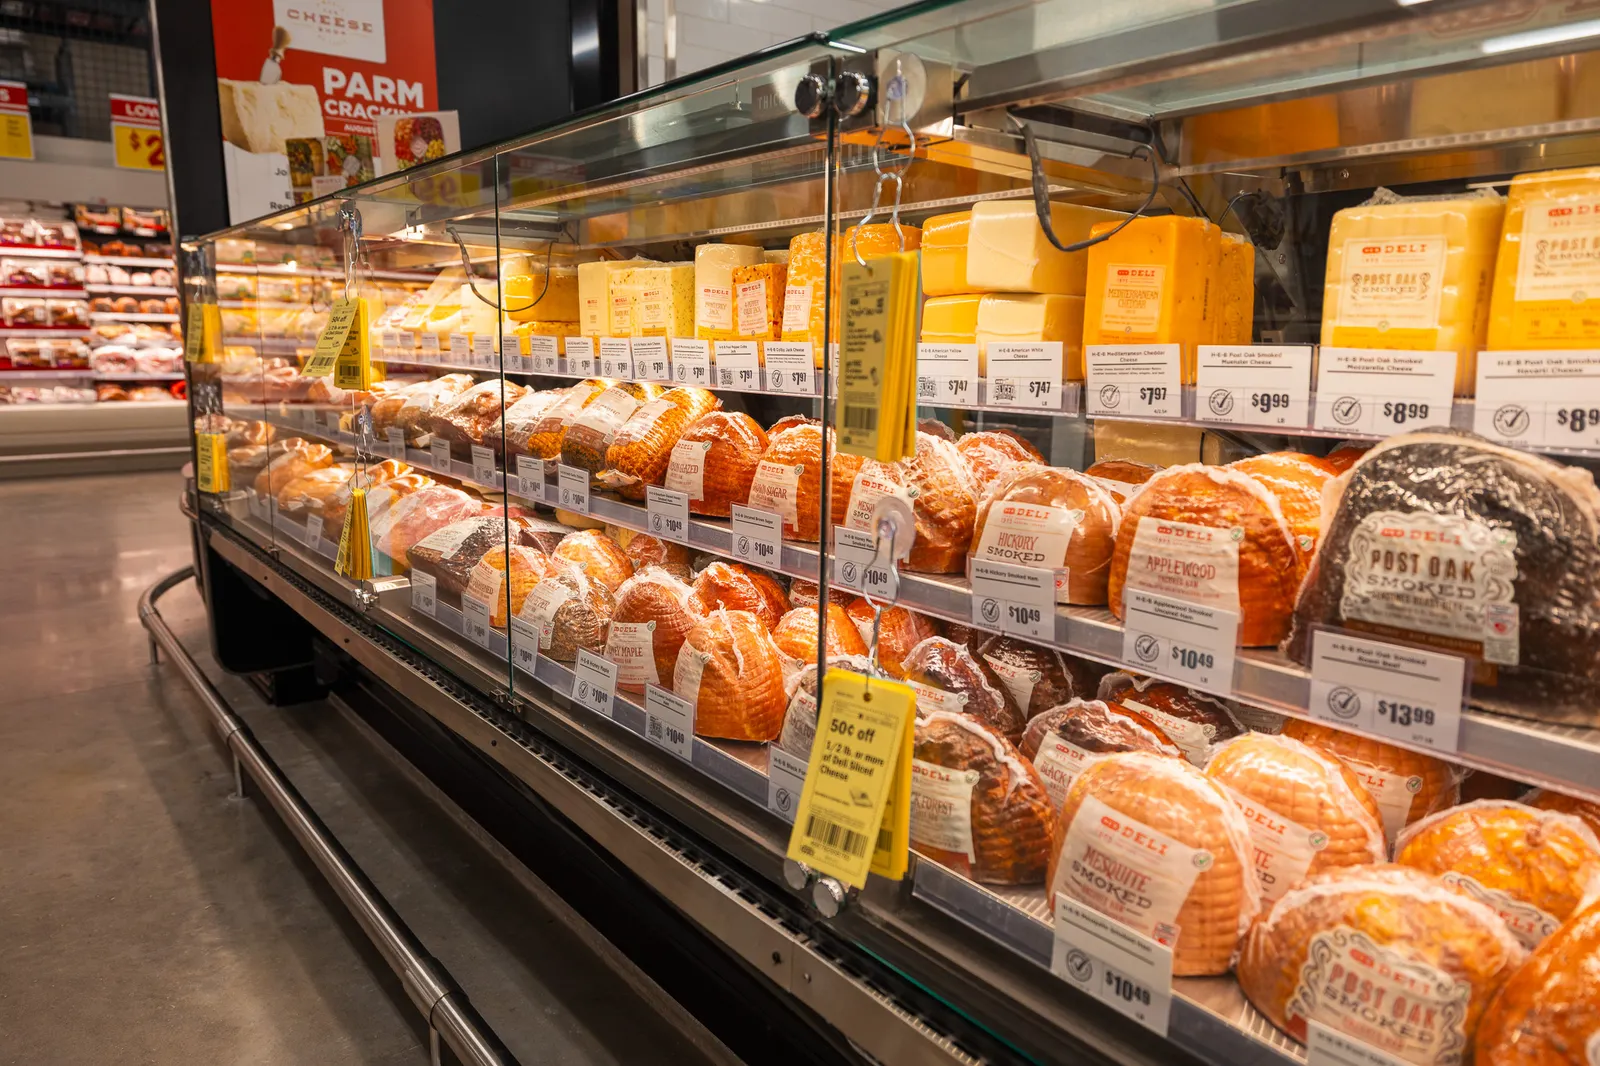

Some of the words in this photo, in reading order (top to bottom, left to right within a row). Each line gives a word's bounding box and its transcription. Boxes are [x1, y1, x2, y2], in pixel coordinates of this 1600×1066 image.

[287, 9, 373, 33] CHEESE
[322, 67, 424, 108] PARM
[1384, 244, 1427, 254] DELI
[1131, 269, 1155, 277] DELI
[1363, 273, 1391, 285] POST
[1362, 286, 1417, 294] SMOKED
[739, 370, 752, 383] $797
[792, 372, 806, 386] $797
[949, 380, 968, 395] $747
[1029, 381, 1051, 398] $747
[1140, 387, 1167, 405] $797
[1251, 393, 1289, 413] $999
[1383, 402, 1429, 424] $899
[766, 485, 788, 500] SUGAR
[871, 481, 896, 495] DELI
[1016, 508, 1050, 520] DELI
[666, 519, 682, 532] $1049
[997, 532, 1039, 551] HICKORY
[1175, 529, 1213, 542] DELI
[1410, 529, 1462, 546] DELI
[754, 541, 774, 557] $1049
[987, 546, 1045, 563] SMOKED
[989, 569, 1007, 578] Hickory
[1007, 571, 1026, 580] Smoked
[1146, 555, 1216, 580] APPLEWOOD
[1370, 549, 1420, 576] POST
[1429, 556, 1475, 583] OAK
[1367, 574, 1476, 599] SMOKED
[1008, 606, 1041, 625] $1049
[1153, 600, 1187, 612] Applewood
[1188, 607, 1213, 618] Smoked
[621, 647, 643, 657] MAPLE
[1171, 646, 1214, 670] $1049
[994, 662, 1016, 678] DELI
[920, 687, 944, 702] DELI
[1378, 700, 1435, 727] $1399
[830, 718, 855, 736] 50¢
[857, 729, 875, 744] off
[1155, 715, 1186, 732] DELI
[666, 726, 685, 744] $1049
[822, 754, 831, 762] of
[820, 764, 848, 781] Cheese
[922, 767, 950, 782] DELI
[1244, 805, 1286, 835] DELI
[1122, 826, 1168, 855] DELI
[1082, 846, 1151, 892] MESQUITE
[1072, 860, 1153, 909] SMOKED
[1105, 970, 1151, 1006] $1049
[1329, 963, 1386, 1010] POST
[1392, 996, 1437, 1029] OAK
[1324, 984, 1435, 1043] SMOKED
